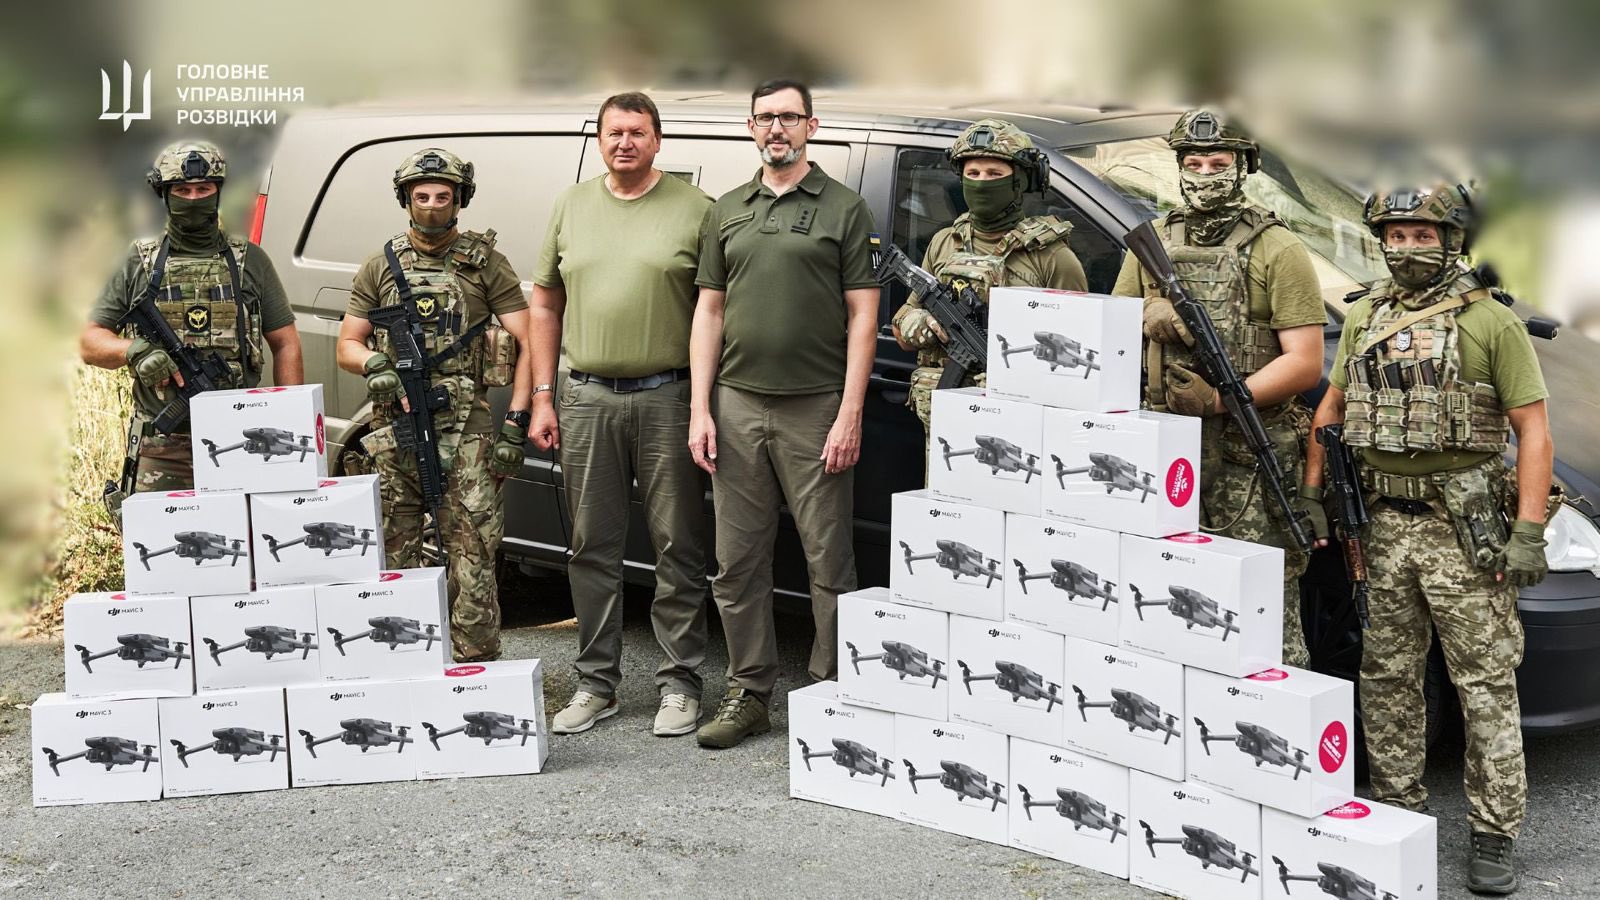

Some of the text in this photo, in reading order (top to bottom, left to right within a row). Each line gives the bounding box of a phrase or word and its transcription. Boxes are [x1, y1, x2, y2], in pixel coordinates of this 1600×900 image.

[306, 495, 324, 503] MAVIC
[941, 511, 958, 519] MAVIC
[1174, 555, 1191, 564] MAVIC
[247, 599, 265, 607] MAVIC
[886, 612, 902, 620] MAVIC
[1000, 631, 1017, 640] MAVIC
[343, 691, 361, 699] MAVIC
[1241, 690, 1259, 700] MAVIC
[89, 709, 108, 717] MAVIC
[945, 731, 961, 740] MAVIC
[1187, 794, 1206, 804] MAVIC
[1322, 831, 1342, 842] MAVIC
